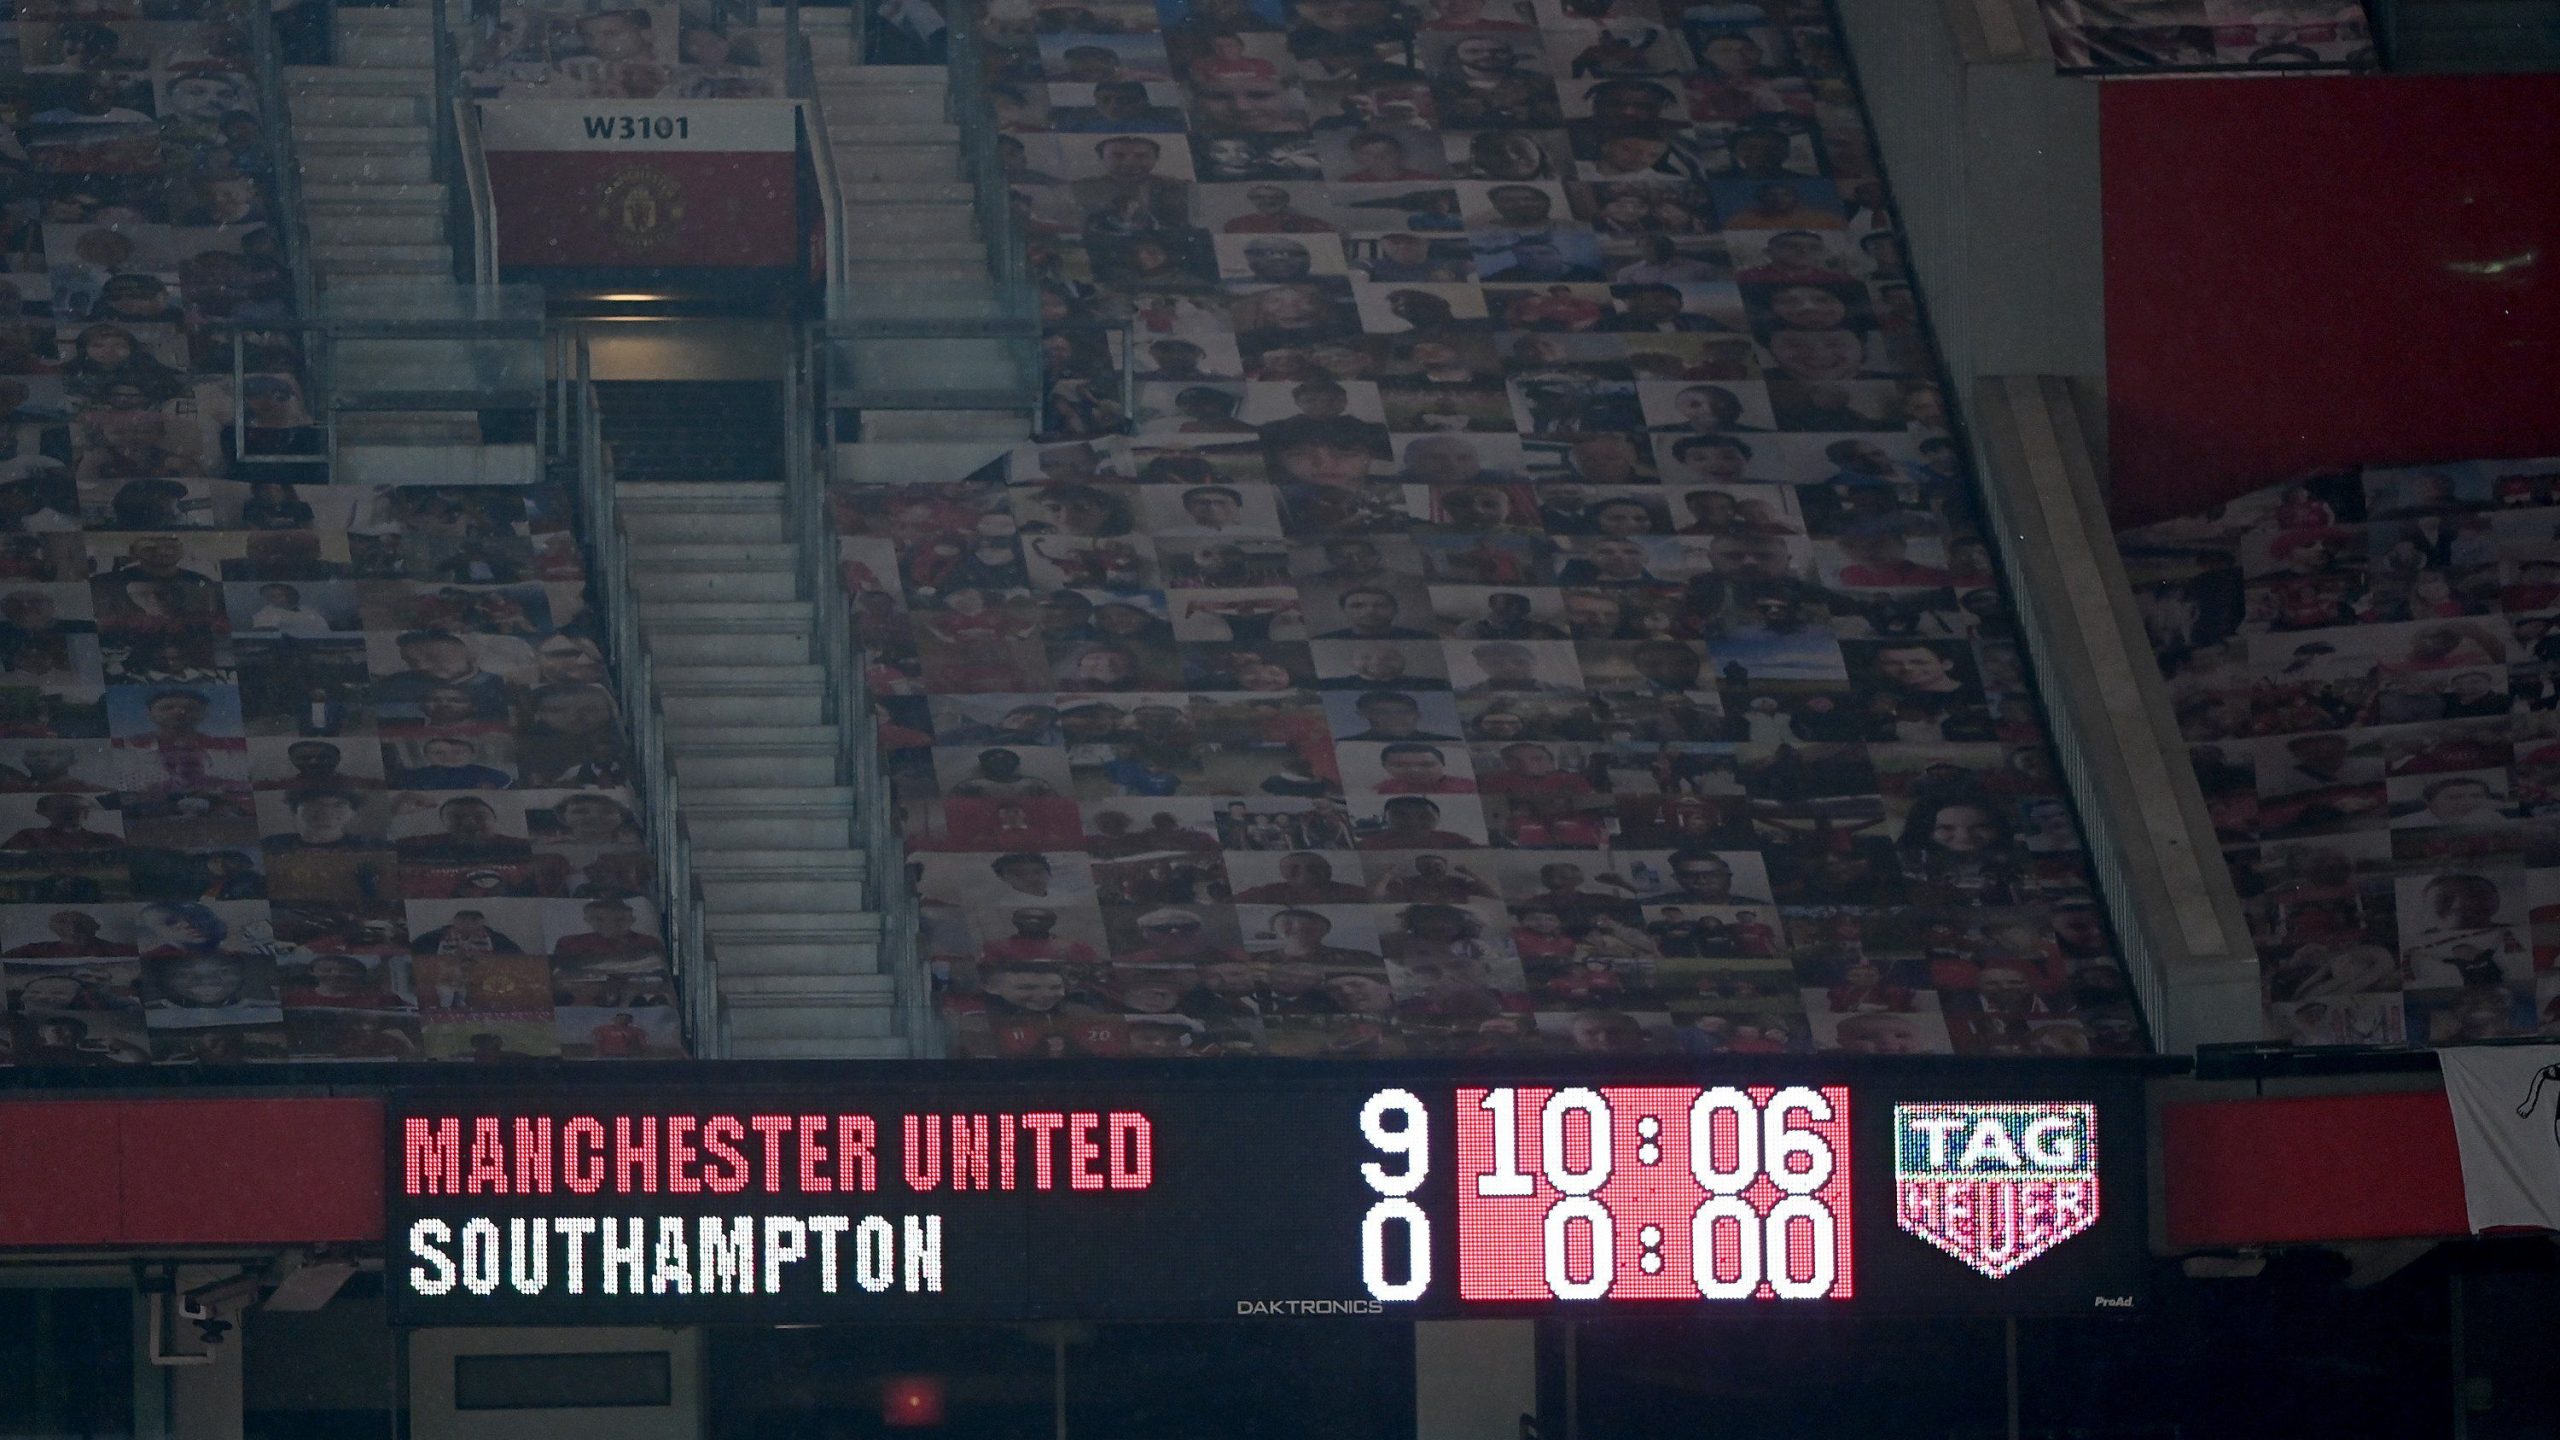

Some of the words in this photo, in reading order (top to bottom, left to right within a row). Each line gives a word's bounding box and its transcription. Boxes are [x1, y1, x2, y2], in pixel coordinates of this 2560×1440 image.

[583, 116, 689, 139] W3101
[405, 1115, 877, 1195] MANCHESTER
[903, 1112, 1153, 1191] UNITED
[1360, 1088, 1430, 1196] 9
[1477, 1087, 1834, 1195] 10:06
[1911, 1118, 2074, 1167] TAG
[409, 1215, 943, 1296] SOUTHAMPTON
[1360, 1198, 1431, 1301] 0
[1543, 1196, 1836, 1300] 0:00
[1907, 1182, 2087, 1260] HEUER
[1237, 1300, 1384, 1315] DAKTRONICS
[2094, 1296, 2133, 1307] ProAd
